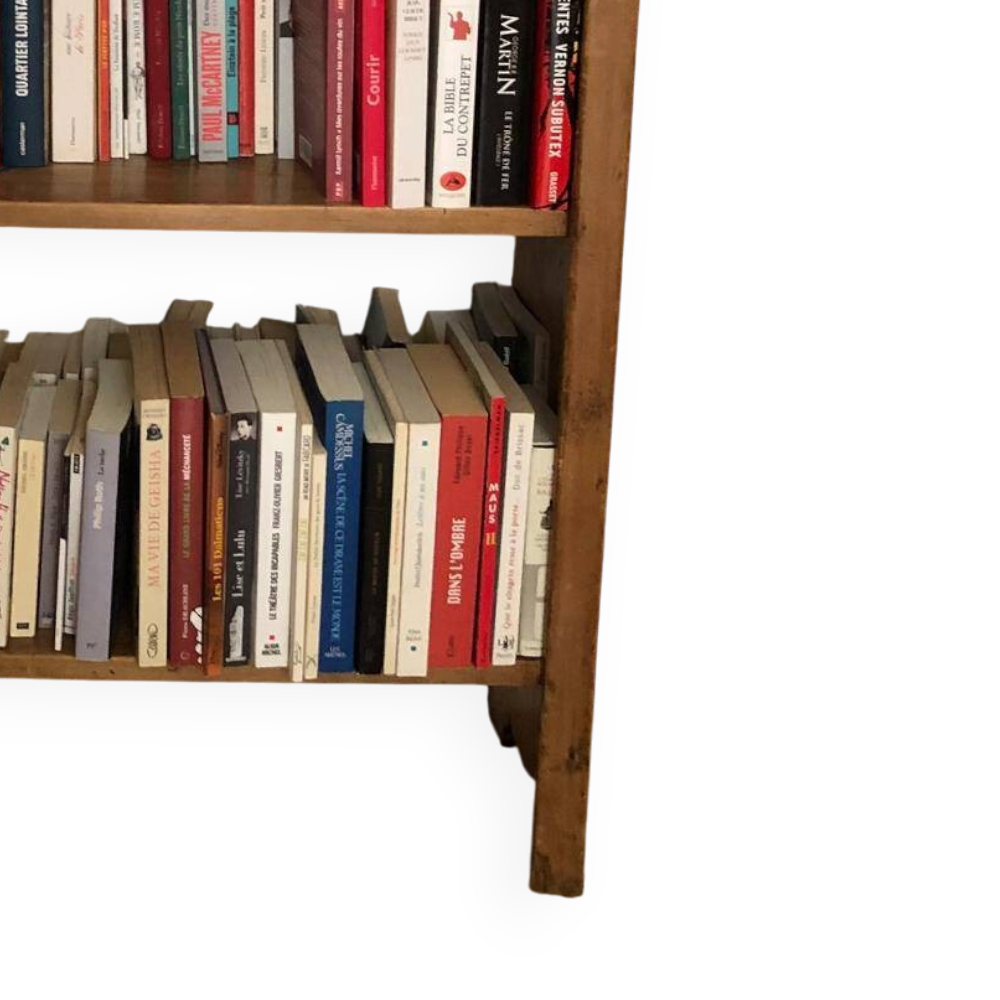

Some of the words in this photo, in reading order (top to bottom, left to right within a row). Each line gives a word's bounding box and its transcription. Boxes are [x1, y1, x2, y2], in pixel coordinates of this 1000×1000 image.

[227, 7, 237, 26] plage
[15, 40, 29, 96] QUARTIER
[227, 46, 236, 78] Einstein
[497, 14, 519, 95] MARTIN
[201, 31, 222, 107] McCARTNEY
[366, 54, 381, 106] Courir
[553, 44, 567, 96] VERNON
[444, 78, 456, 113] BIBLE
[458, 54, 472, 133] CONTREPET
[202, 110, 222, 141] PAUL
[443, 118, 454, 134] LA
[504, 111, 512, 122] LE
[549, 100, 564, 157] SUBUTEX
[457, 136, 469, 156] DU
[503, 125, 514, 156] TRÔNE
[502, 159, 511, 171] DE
[501, 174, 510, 190] FER
[548, 171, 558, 203] GRASSET
[333, 413, 346, 470] CAMDESSUS
[344, 424, 354, 458] MICHEL
[456, 426, 466, 454] Philippe
[513, 424, 524, 456] Brissac
[182, 434, 191, 480] MÉCHANCETÉ
[274, 451, 283, 481] GIESBERT
[512, 460, 522, 470] de
[93, 481, 104, 502] Roth
[149, 450, 161, 508] GEISHA
[337, 473, 346, 483] LA
[512, 474, 521, 490] Duc
[272, 483, 282, 529] FRANZ-OLIVIER
[336, 485, 348, 512] SCÈNE
[488, 482, 499, 524] MAUS
[93, 505, 103, 529] Philip
[148, 512, 161, 532] DE
[214, 497, 224, 558] Dalmatiens
[335, 516, 345, 528] DE
[148, 535, 161, 560] VIE
[234, 530, 246, 557] Lulu
[334, 530, 344, 542] CE
[449, 518, 466, 570] L'OMBRE
[270, 533, 280, 570] INCAPABLES
[333, 544, 344, 577] DRAME
[148, 563, 160, 587] MA
[213, 562, 223, 580] 101
[234, 560, 245, 572] et
[269, 572, 278, 583] DES
[213, 583, 222, 601] Les
[232, 574, 244, 597] Lise
[267, 585, 278, 611] THÉÂTRE
[333, 578, 342, 593] EST
[447, 573, 462, 604] DANS
[332, 596, 342, 605] LE
[331, 607, 341, 640] MONDE
